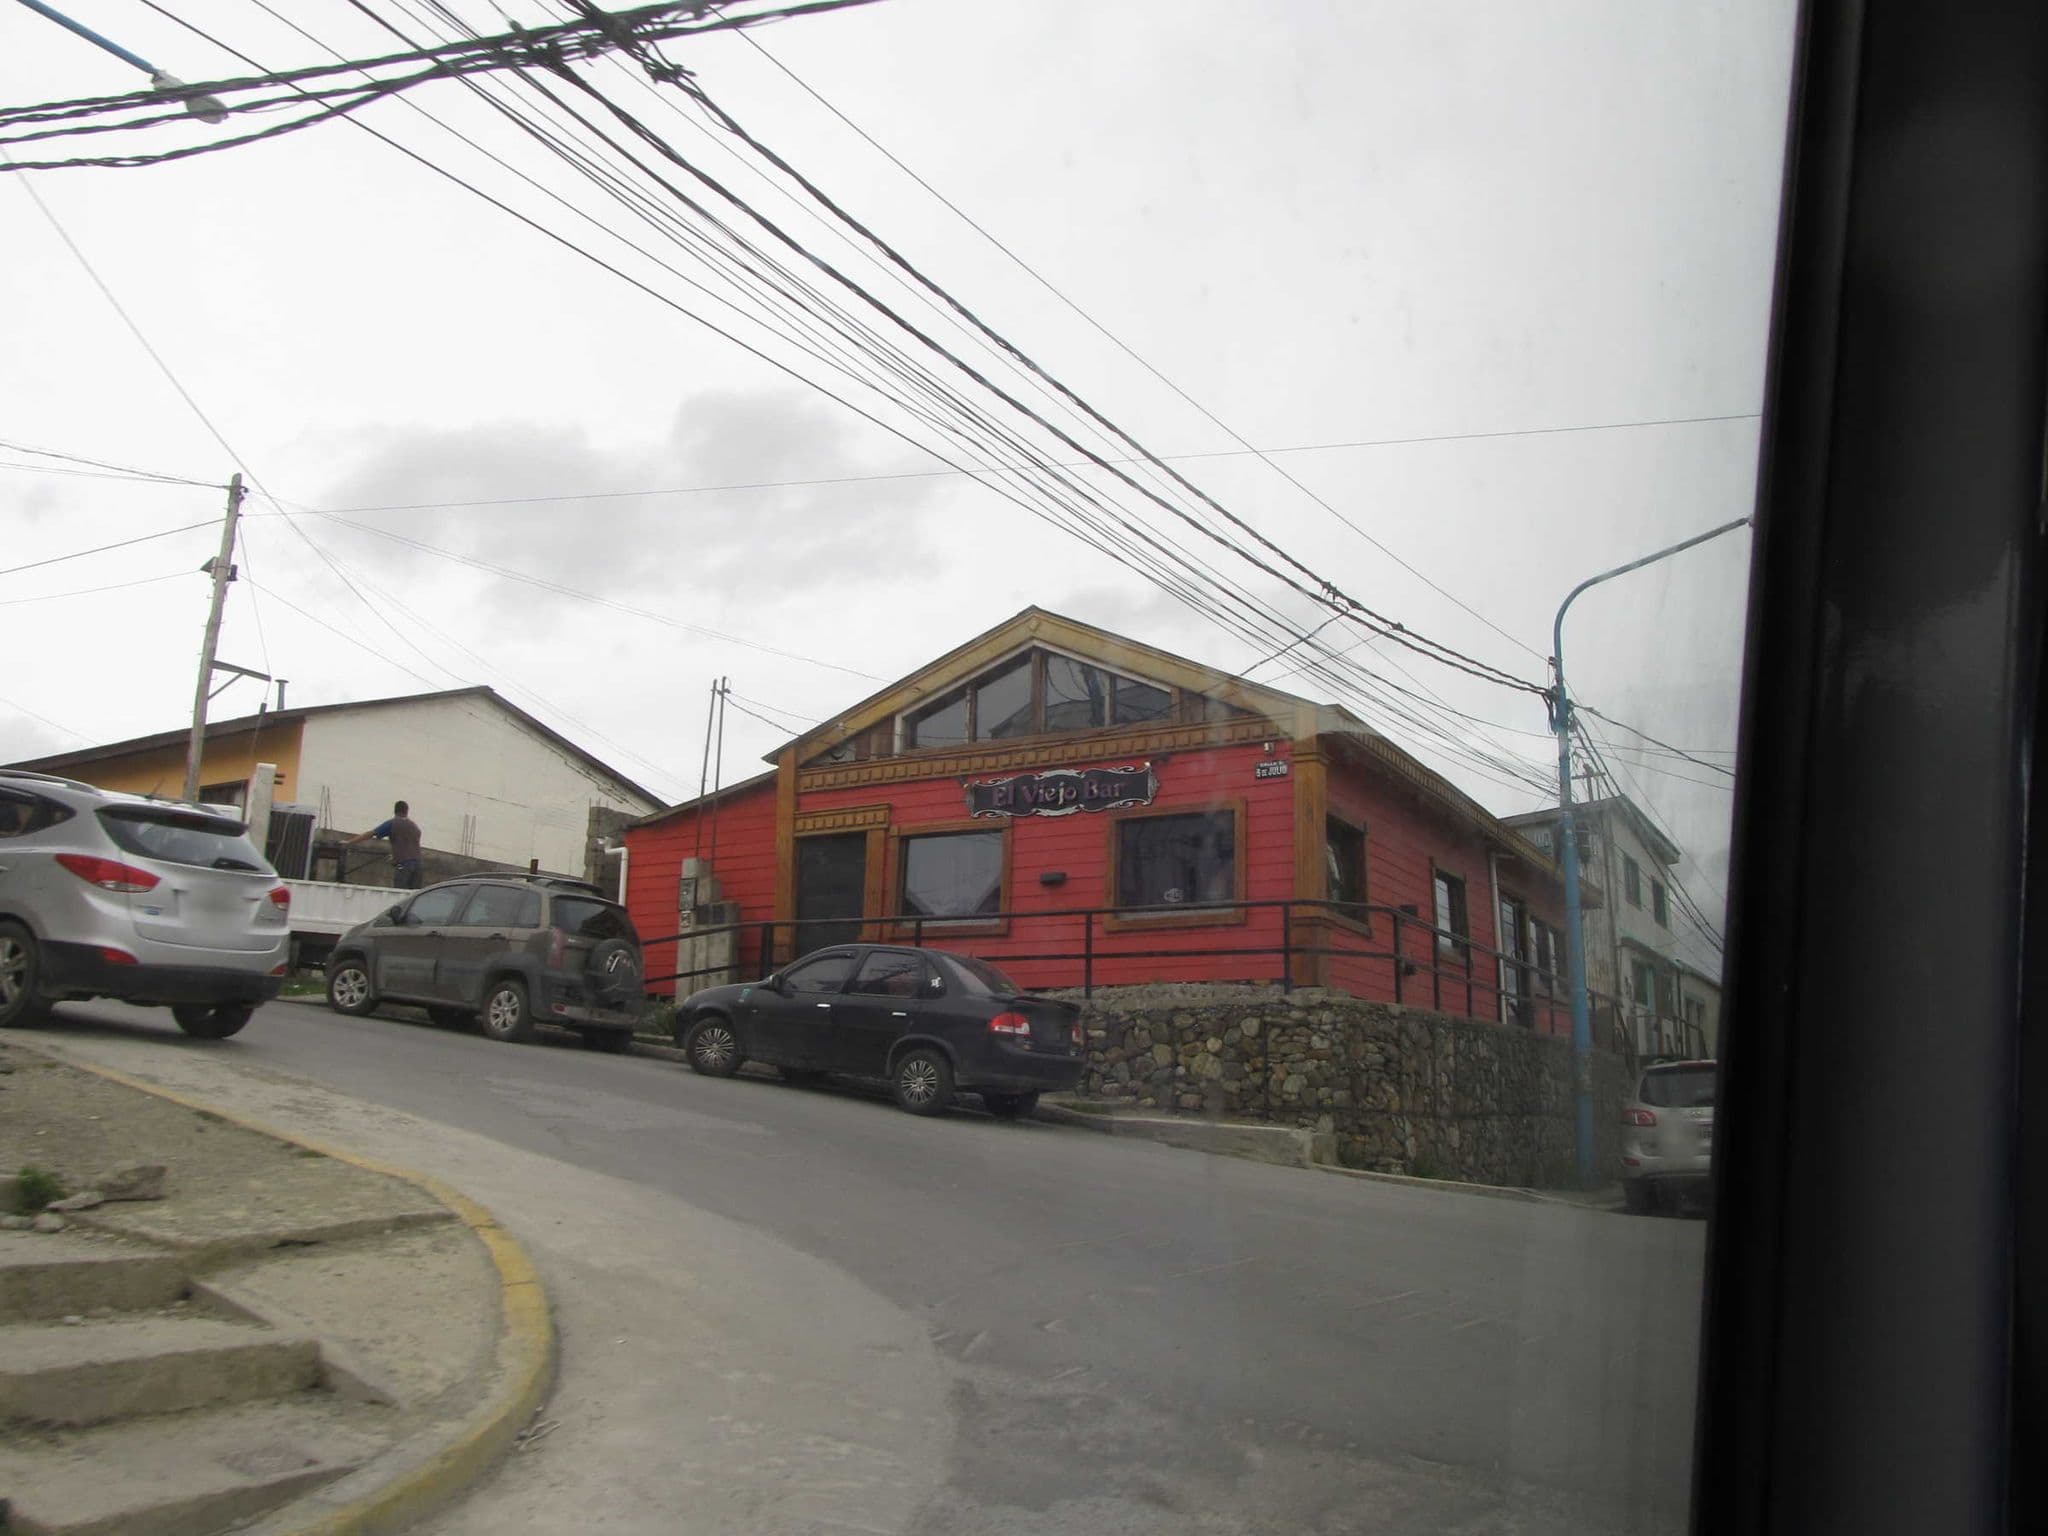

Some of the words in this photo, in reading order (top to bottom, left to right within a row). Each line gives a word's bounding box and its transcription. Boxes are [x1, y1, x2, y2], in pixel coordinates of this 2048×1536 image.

[993, 786, 1014, 807] El
[1022, 780, 1077, 805] Viejo
[1084, 779, 1127, 800] Bar
